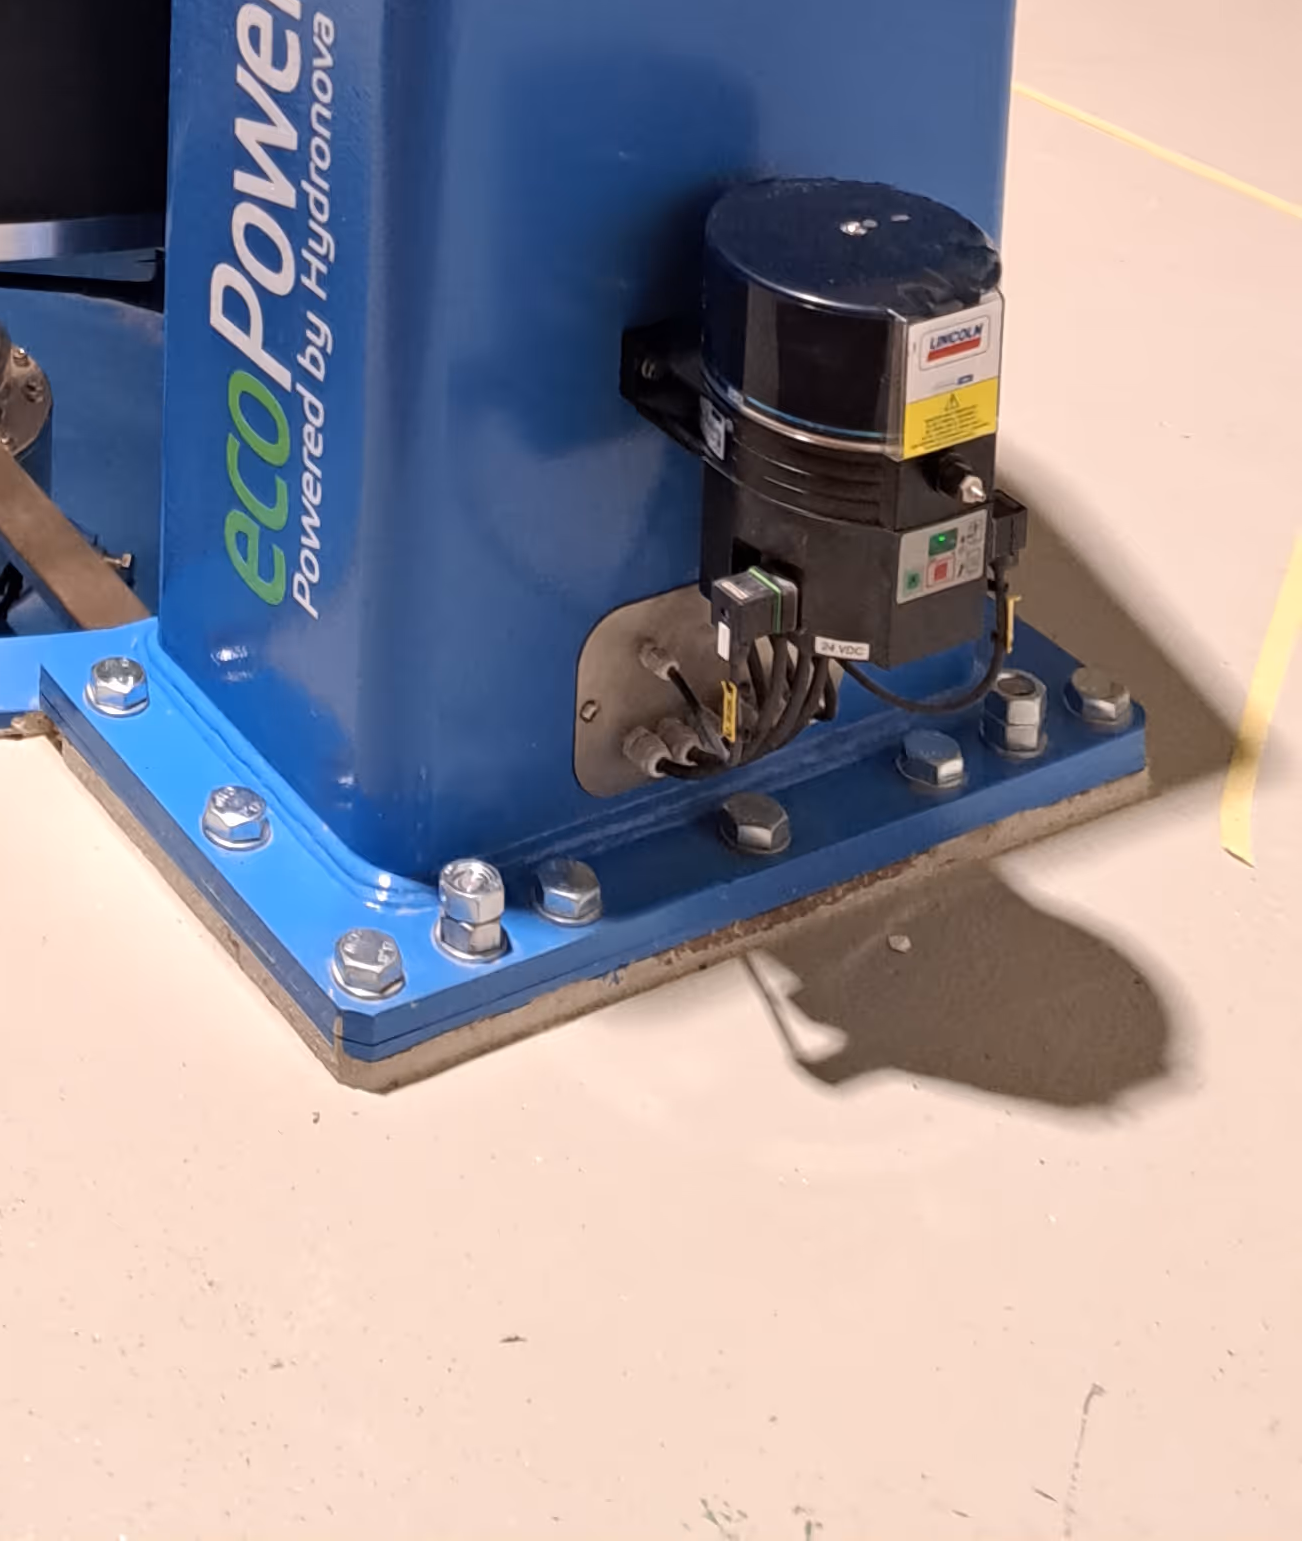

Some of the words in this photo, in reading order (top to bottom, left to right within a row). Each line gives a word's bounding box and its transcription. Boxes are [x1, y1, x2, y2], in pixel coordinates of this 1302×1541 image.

[300, 11, 335, 301] Hydronova
[296, 310, 333, 382] by
[929, 322, 983, 350] LINCOLN
[292, 382, 325, 620] Powered
[838, 643, 865, 656] VDC
